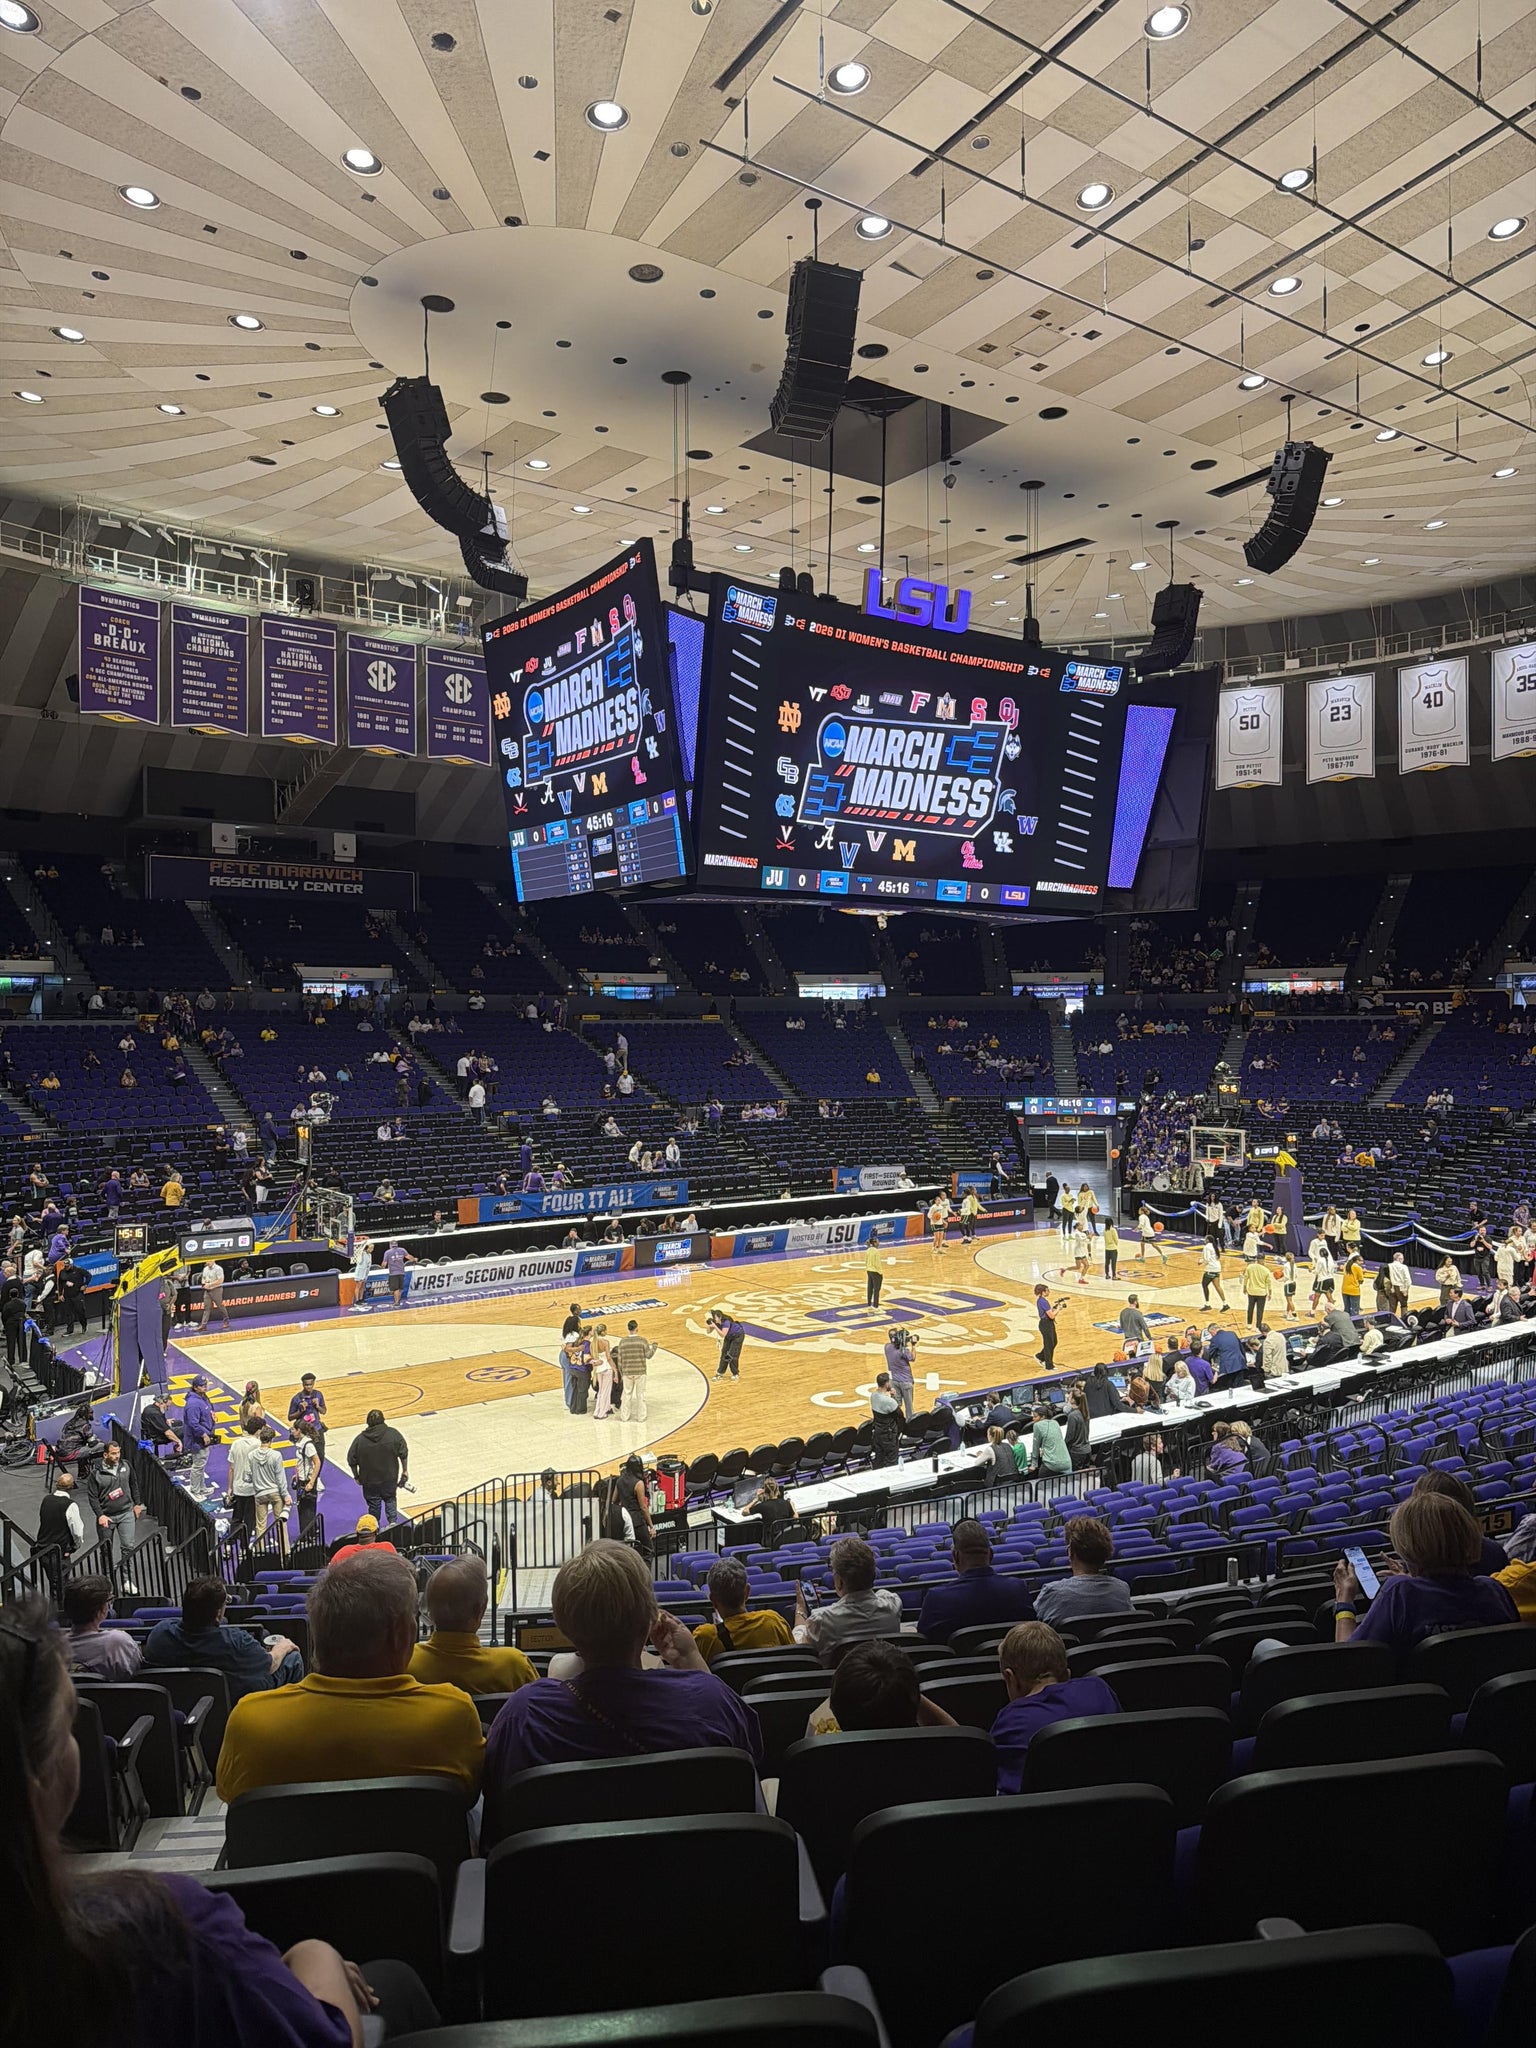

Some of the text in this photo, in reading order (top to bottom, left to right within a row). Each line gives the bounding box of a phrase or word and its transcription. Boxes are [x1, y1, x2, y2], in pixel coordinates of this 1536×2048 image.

[100, 595, 140, 610] GYMNASTICS
[502, 562, 629, 636] 2026 DI WOMEN'S BASKETBALL CHAMPIONSHIP
[736, 591, 763, 610] MARCH
[864, 567, 972, 634] LSU
[110, 616, 131, 625] COACH
[192, 613, 229, 625] GYMNASTICS
[609, 607, 620, 634] S
[738, 605, 774, 627] MADNESS
[191, 636, 230, 649] NATIONAL
[281, 629, 317, 640] GYMNASTICS
[575, 627, 587, 654] F
[93, 633, 146, 654] BREAUX
[186, 643, 234, 657] CHAMPIONS
[364, 641, 399, 653] GYMNASTICS
[809, 621, 1024, 674] 2026 DI WOMEN'S BASKETBALL CHAMPIONSHIP
[276, 658, 323, 671] CHAMPIONS
[281, 651, 318, 663] NATIONAL
[442, 655, 475, 666] GYMNASTICS
[367, 660, 397, 692] SEC
[1076, 665, 1106, 680] MARCH
[444, 673, 473, 704] SEC
[544, 659, 605, 722] MARCH
[1078, 677, 1119, 691] MADNESS
[1516, 672, 1536, 693] 35
[809, 686, 828, 702] VT
[910, 690, 931, 714] F
[1423, 690, 1444, 709] 40
[442, 706, 476, 717] CHAMPIONS
[971, 697, 988, 722] S
[1330, 704, 1352, 723] 23
[555, 687, 639, 757] MADNESS
[1239, 714, 1260, 731] 50
[824, 737, 845, 750] NCAA
[844, 725, 945, 771] MARCH
[1421, 749, 1447, 759] 1976-81
[1235, 768, 1262, 777] 1951-54
[1327, 761, 1354, 770] 1967-70
[591, 771, 609, 796] M
[850, 767, 994, 818] MADNESS
[512, 831, 525, 847] JU
[532, 831, 539, 842] 0
[576, 825, 580, 835] 1
[586, 811, 613, 832] 45:16
[1017, 815, 1038, 836] W
[892, 838, 917, 863] M
[704, 853, 759, 869] MARCHMADNESS
[209, 862, 363, 881] PETE MARAVICH
[209, 876, 364, 894] ASSEMBLY CENTER
[765, 869, 1026, 901] JU 0 1 45:16 0 LSU
[1036, 880, 1099, 896] MARCHMADNESS
[1031, 1106, 1037, 1114] 0
[1104, 1106, 1110, 1115] 0
[1059, 1099, 1081, 1107] 45:16
[1056, 1116, 1081, 1125] LSU
[541, 1188, 635, 1213] FOUR IT ALL
[501, 1205, 521, 1214] MADNESS
[119, 1228, 143, 1238] 45:16
[751, 1236, 766, 1244] MARCH
[791, 1233, 824, 1242] HOSTED BY
[826, 1224, 855, 1244] LSU
[203, 1238, 234, 1250] ESPN
[662, 1242, 681, 1250] MARCH
[753, 1241, 774, 1250] MADNESS
[665, 1248, 691, 1257] MADNESS
[415, 1273, 453, 1290] FIRST
[465, 1266, 515, 1285] SECOND
[519, 1259, 574, 1278] ROUNDS
[221, 1297, 253, 1307] MARCH
[255, 1291, 296, 1303] MADNESS
[654, 1521, 676, 1532] ARMOR
[1483, 1514, 1505, 1530] 15
